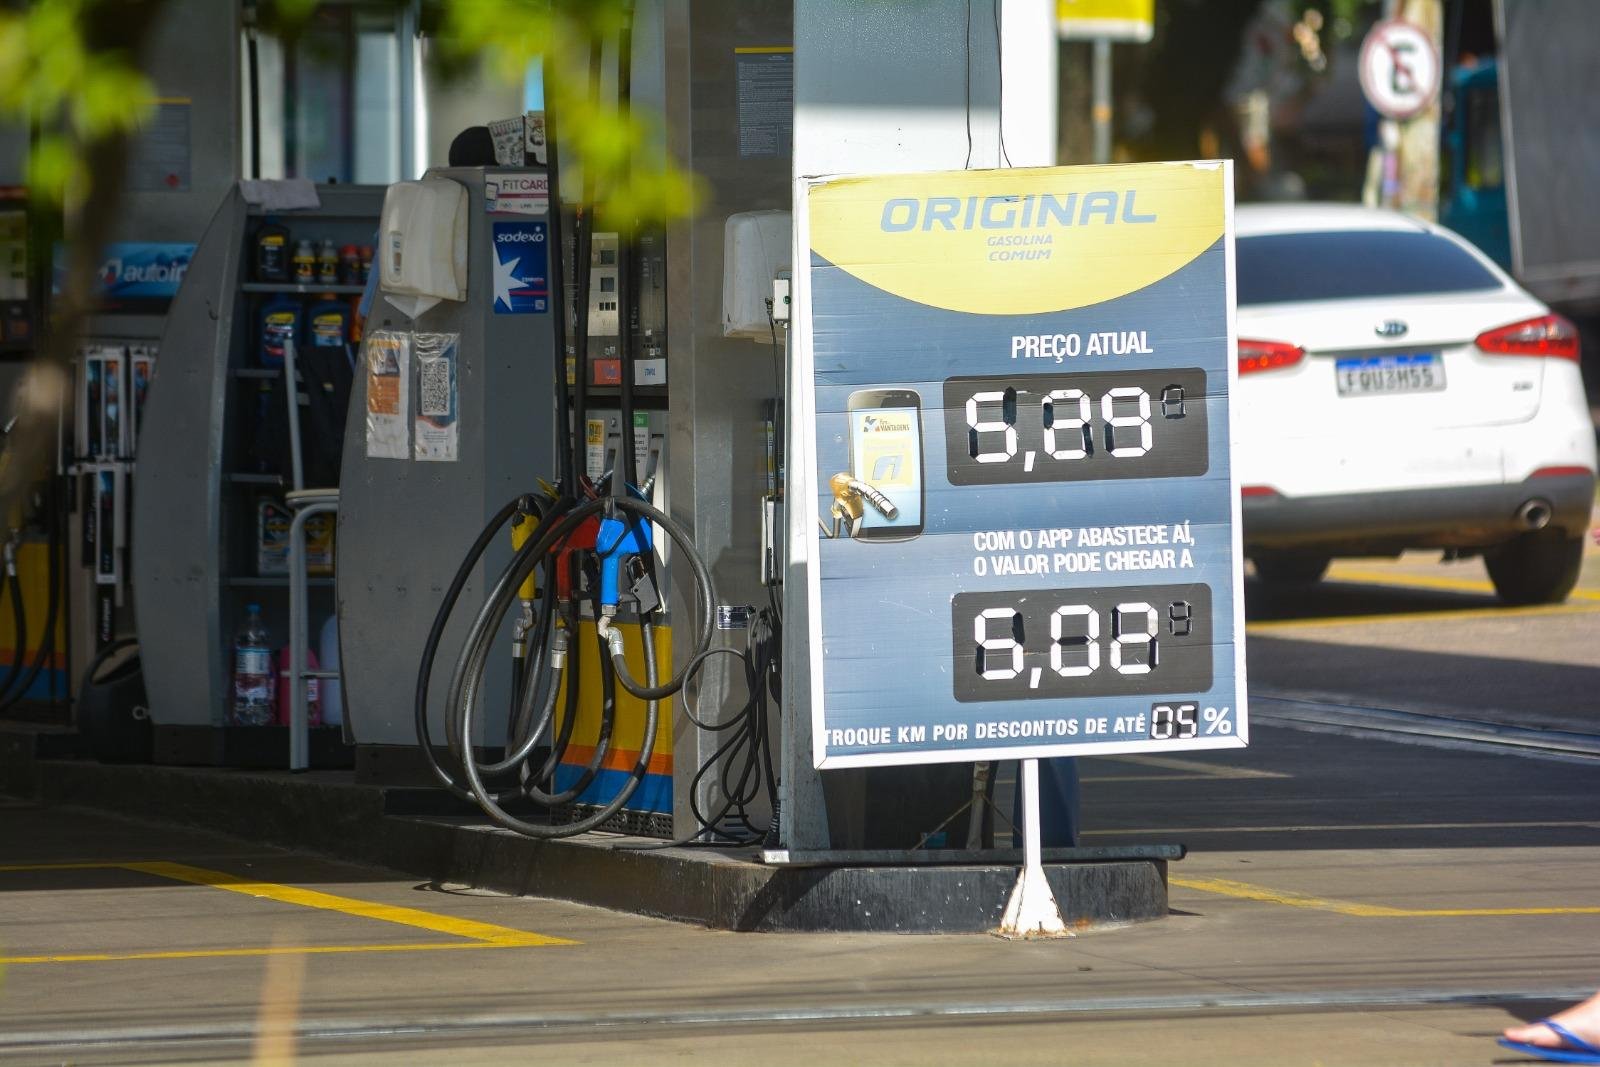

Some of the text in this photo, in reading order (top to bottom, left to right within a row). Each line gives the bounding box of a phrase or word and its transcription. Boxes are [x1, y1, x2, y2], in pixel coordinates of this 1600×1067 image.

[880, 190, 1157, 232] ORIGINAL
[497, 231, 544, 243] sodexo
[987, 234, 1053, 248] GASOLINA
[988, 249, 1052, 262] COMUM
[1011, 330, 1154, 364] PREÇO ATUAL
[974, 519, 1195, 551] COM O APP ABASTECE AÍ,
[974, 548, 1194, 576] O VALOR PODE CHEGAR A
[825, 727, 891, 746] TROQUE
[898, 725, 926, 743] KM
[933, 723, 968, 741] POR
[975, 718, 1078, 739] DESCONTOS
[1085, 717, 1107, 734] DE
[1113, 713, 1146, 733] ATÉ
[1151, 704, 1197, 739] 05
